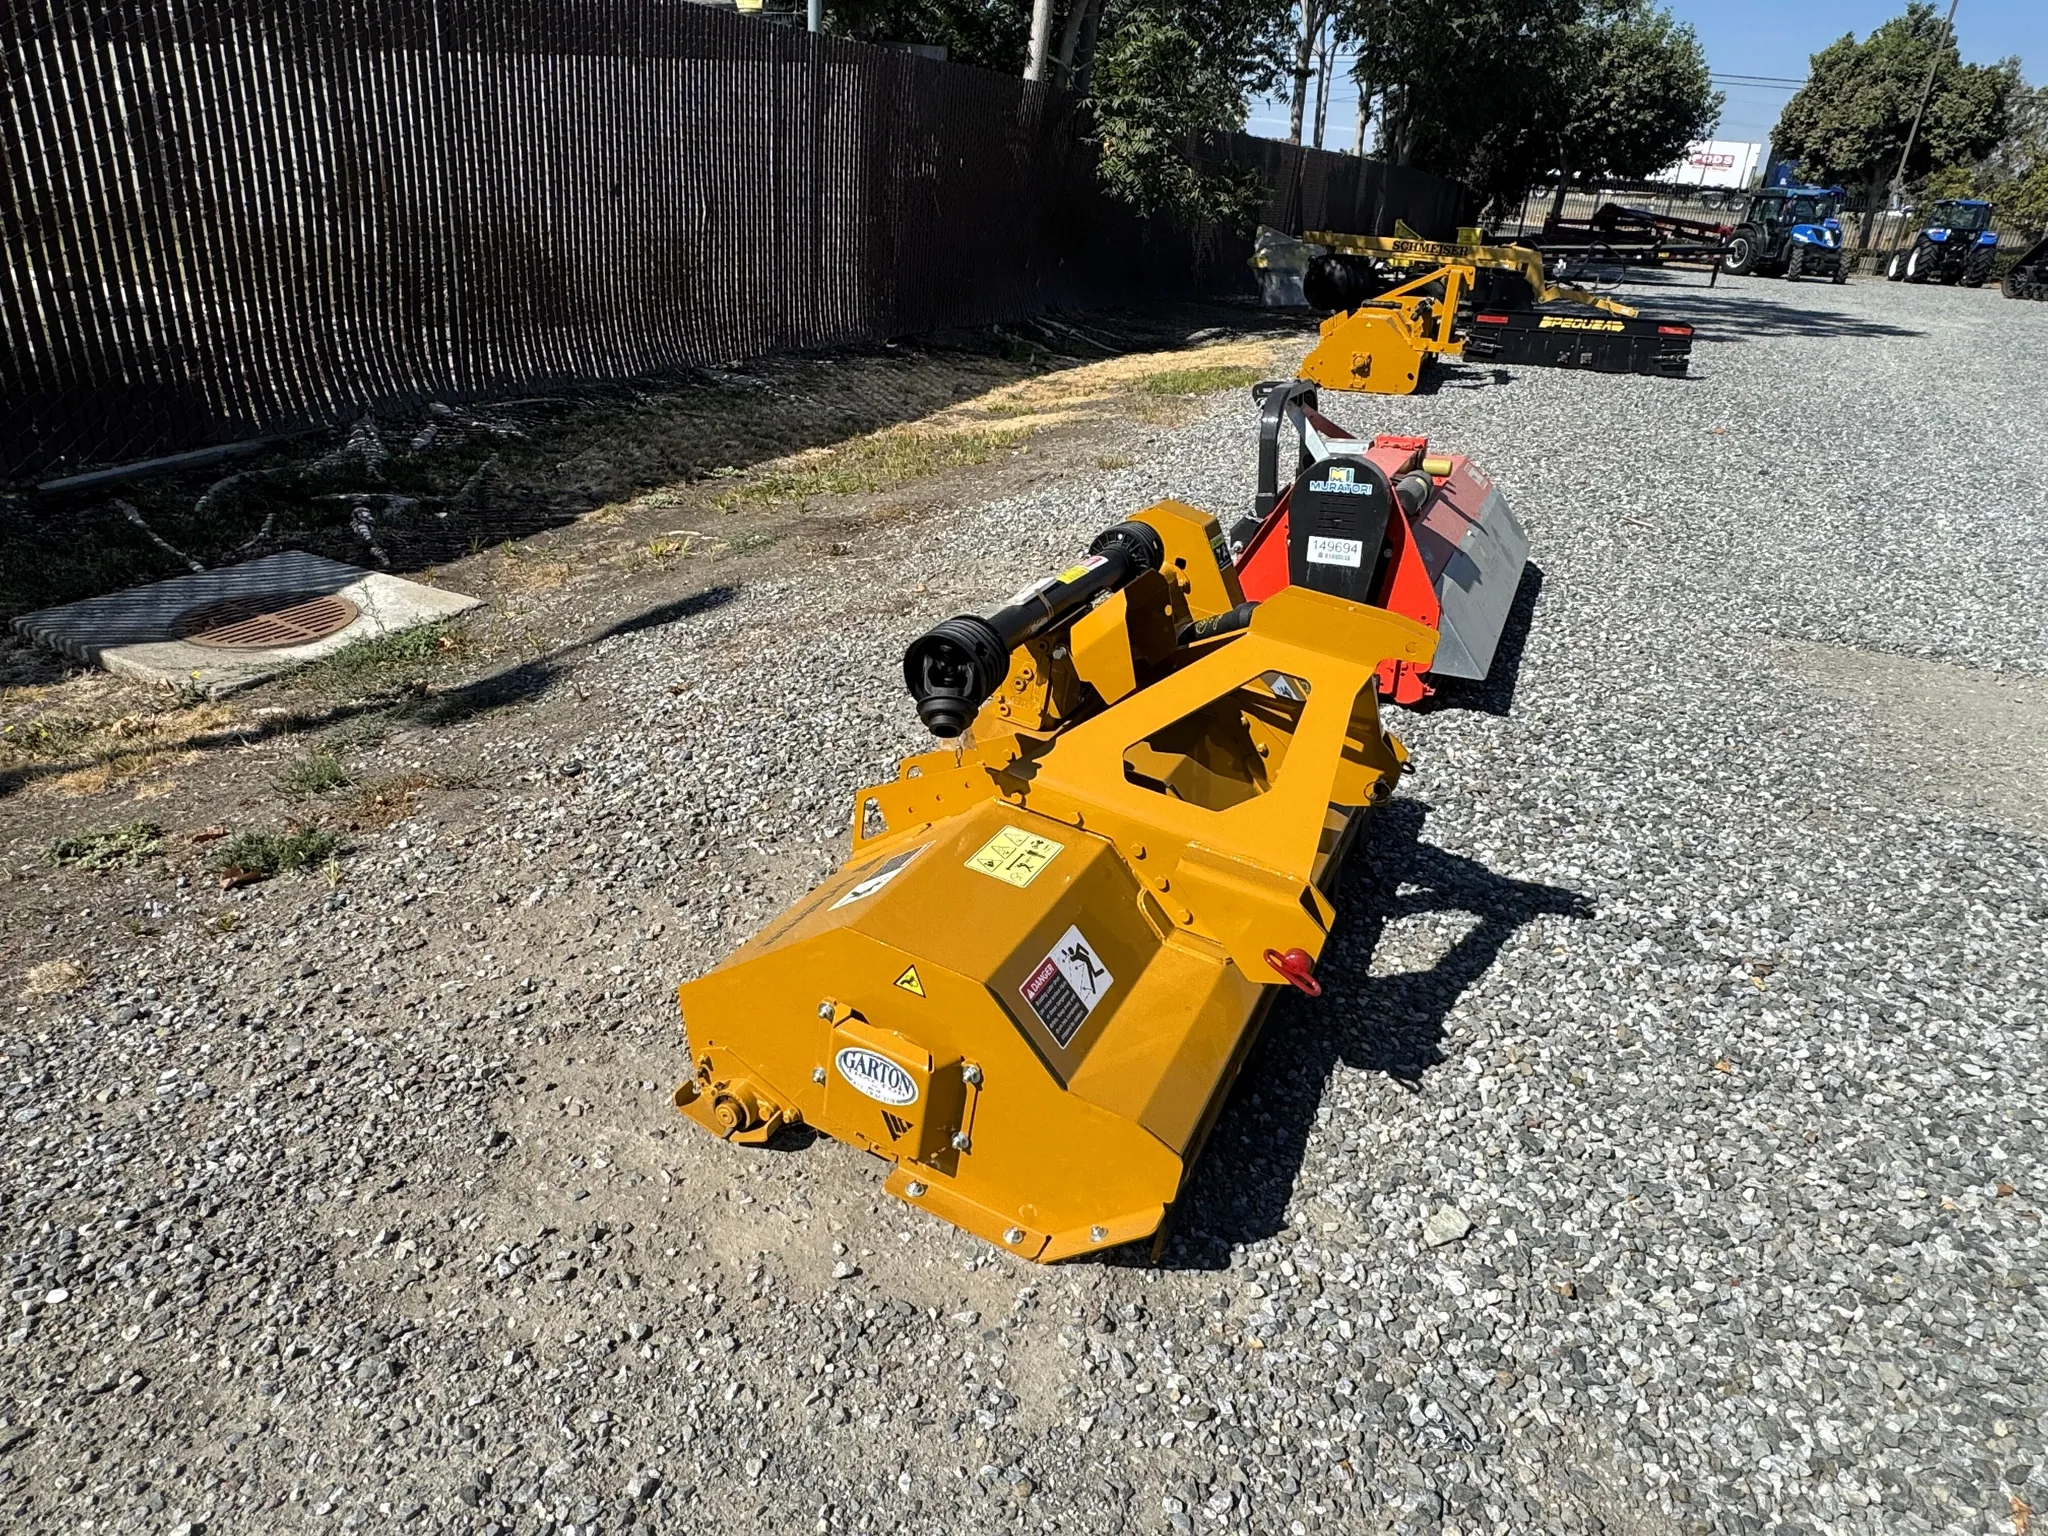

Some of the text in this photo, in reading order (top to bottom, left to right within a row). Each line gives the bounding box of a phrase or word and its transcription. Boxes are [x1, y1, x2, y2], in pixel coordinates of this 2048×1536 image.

[1692, 153, 1733, 165] PODS
[1392, 240, 1469, 256] SCHMEISER
[1310, 481, 1372, 495] MURATORI
[1312, 540, 1358, 554] 149694
[1031, 963, 1056, 992] DANGER
[841, 1050, 912, 1095] GARTON
